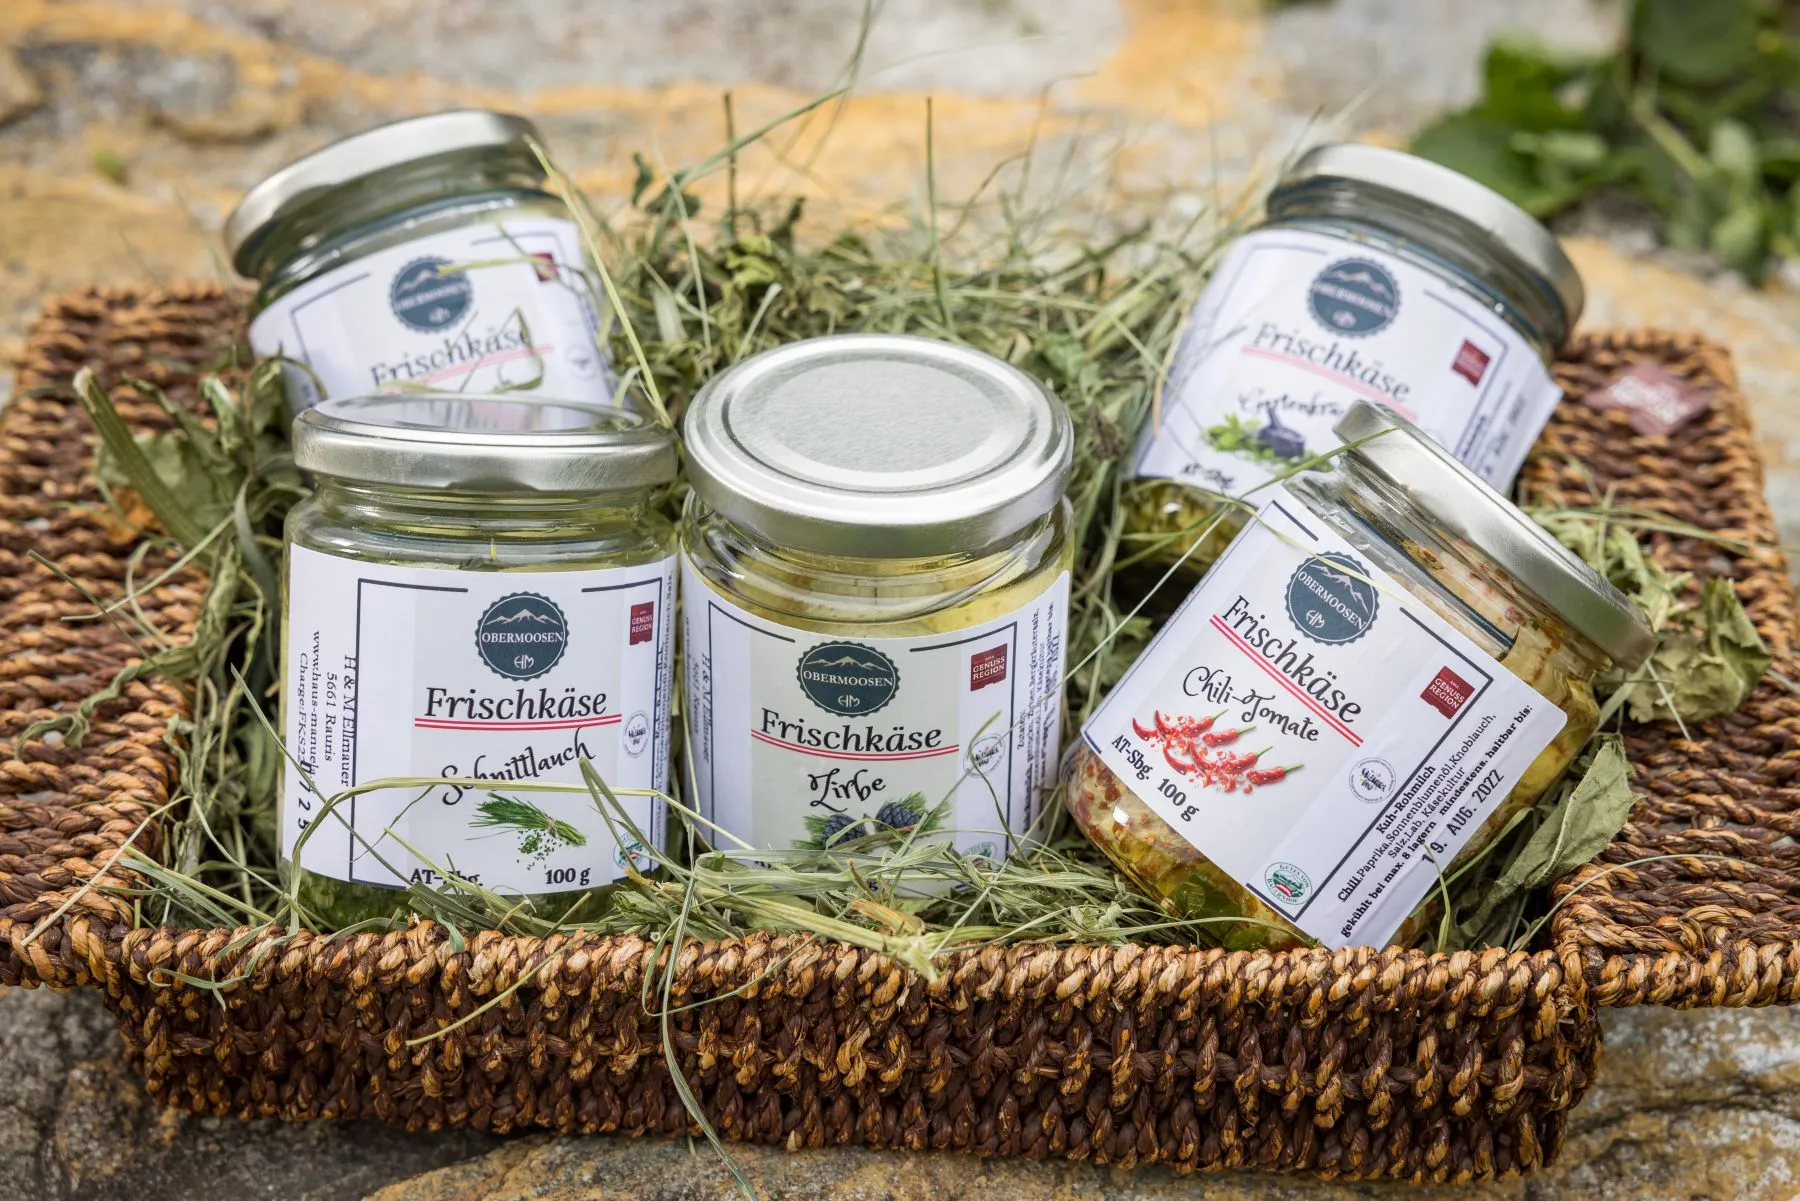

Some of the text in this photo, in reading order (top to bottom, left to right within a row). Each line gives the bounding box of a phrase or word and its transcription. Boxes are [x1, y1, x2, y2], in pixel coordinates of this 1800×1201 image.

[1253, 322, 1411, 403] Frischkäse
[631, 614, 653, 626] GENUSS
[1298, 571, 1367, 630] OBERMOOSEN
[481, 630, 563, 644] OBERMOOSEN
[631, 623, 652, 633] REGION
[802, 670, 894, 688] OBERMOOSEN
[973, 656, 1005, 673] GENUSS
[973, 663, 1005, 680] REGION
[1221, 595, 1364, 725] Frischkäse
[424, 687, 607, 720] Frischkäse
[1183, 666, 1319, 742] Chili-Tomate
[1429, 683, 1460, 709] REGION
[1434, 678, 1465, 703] GENUSS
[324, 671, 338, 761] 5661 Rauris
[340, 654, 357, 786] H & M Ellmauer
[761, 707, 942, 752] Frischkäse
[1112, 735, 1153, 780] AT-Sbg.
[807, 767, 887, 813] Zirbe
[1157, 778, 1200, 822] 100 g
[1376, 764, 1436, 835] Kuh-Rohmilch
[1422, 766, 1466, 817] Käsekultur
[1446, 805, 1478, 836] AUG.
[1471, 768, 1505, 804] 2022
[1341, 704, 1534, 938] gekühlt bei max. 8 lagern mindestens. haltbar bis:
[545, 867, 591, 886] 100 g
